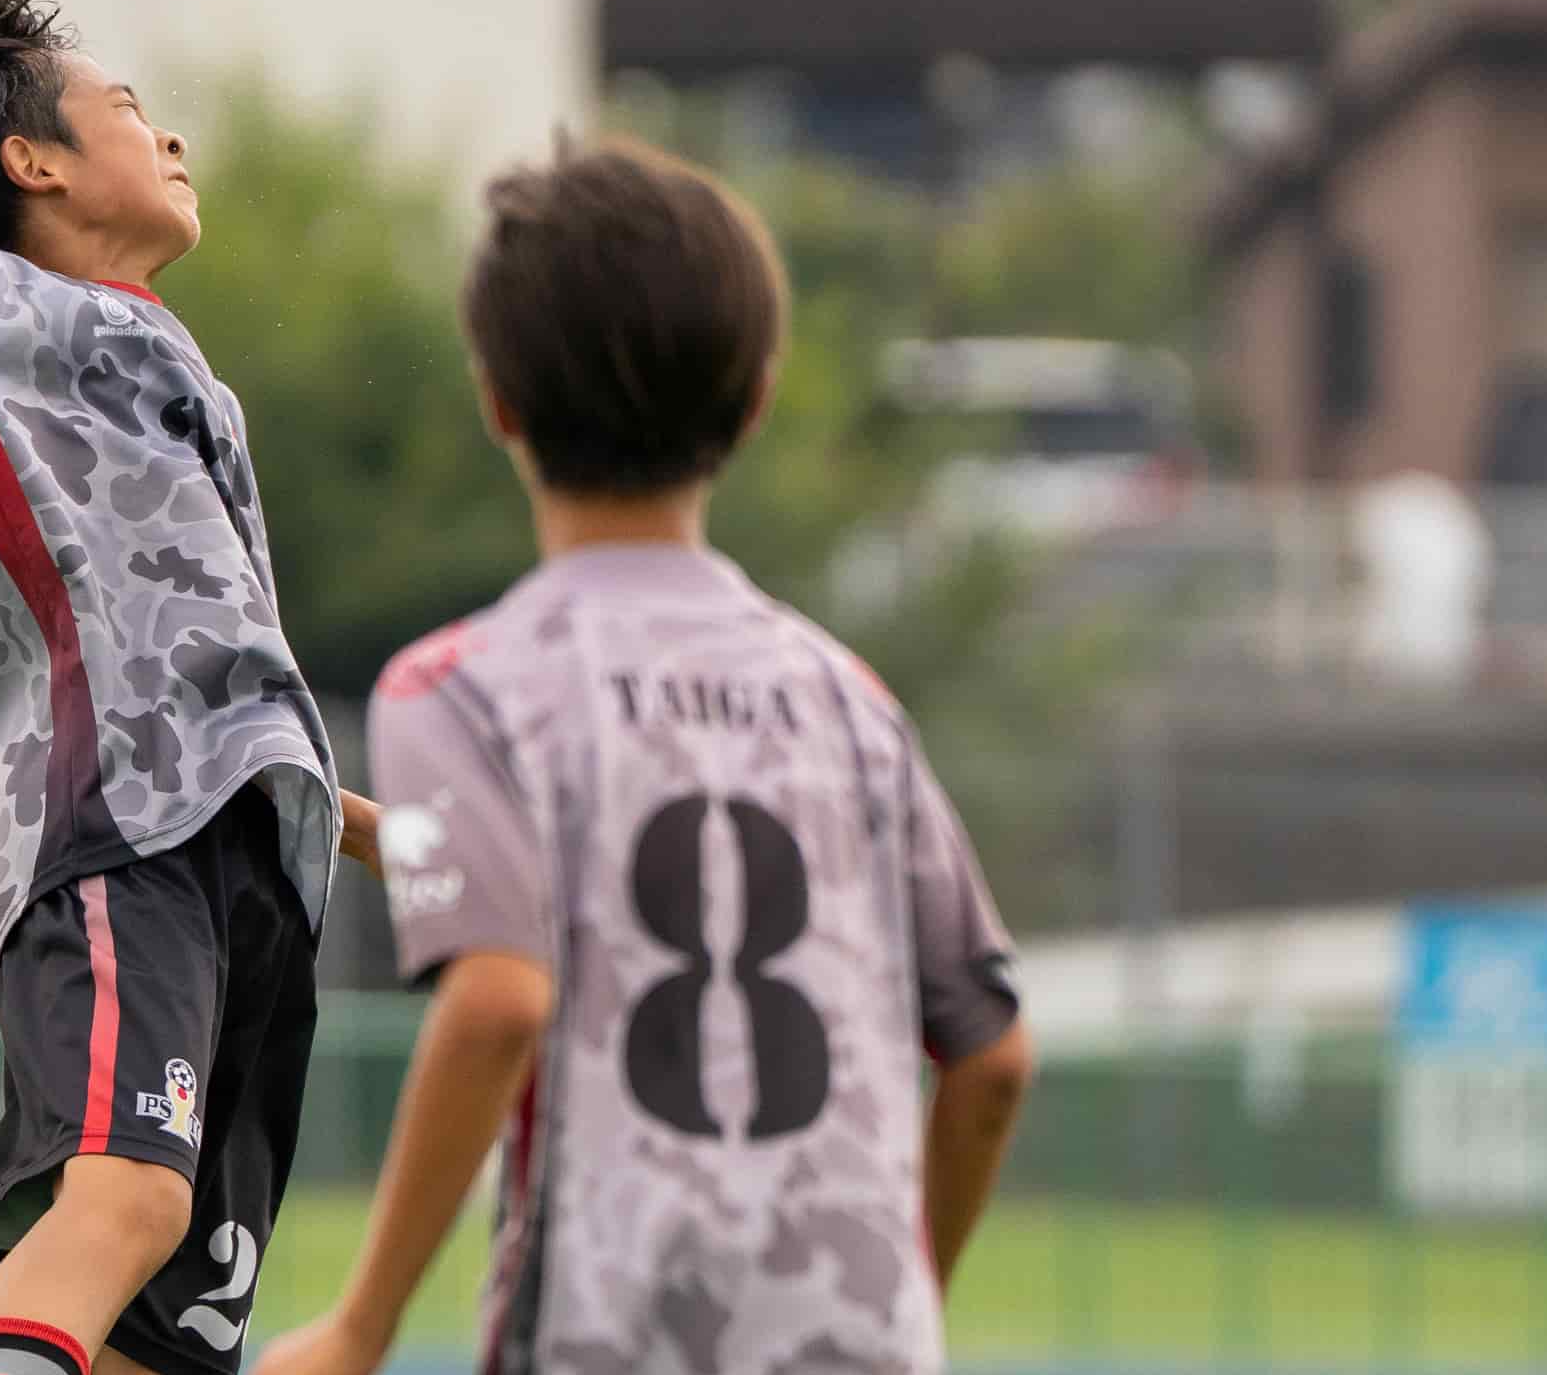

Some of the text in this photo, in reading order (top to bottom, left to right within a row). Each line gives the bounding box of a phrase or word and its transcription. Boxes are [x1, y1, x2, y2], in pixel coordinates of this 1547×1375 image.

[608, 671, 802, 736] TAIGA
[622, 793, 831, 1142] 8
[177, 1220, 258, 1352] 2
